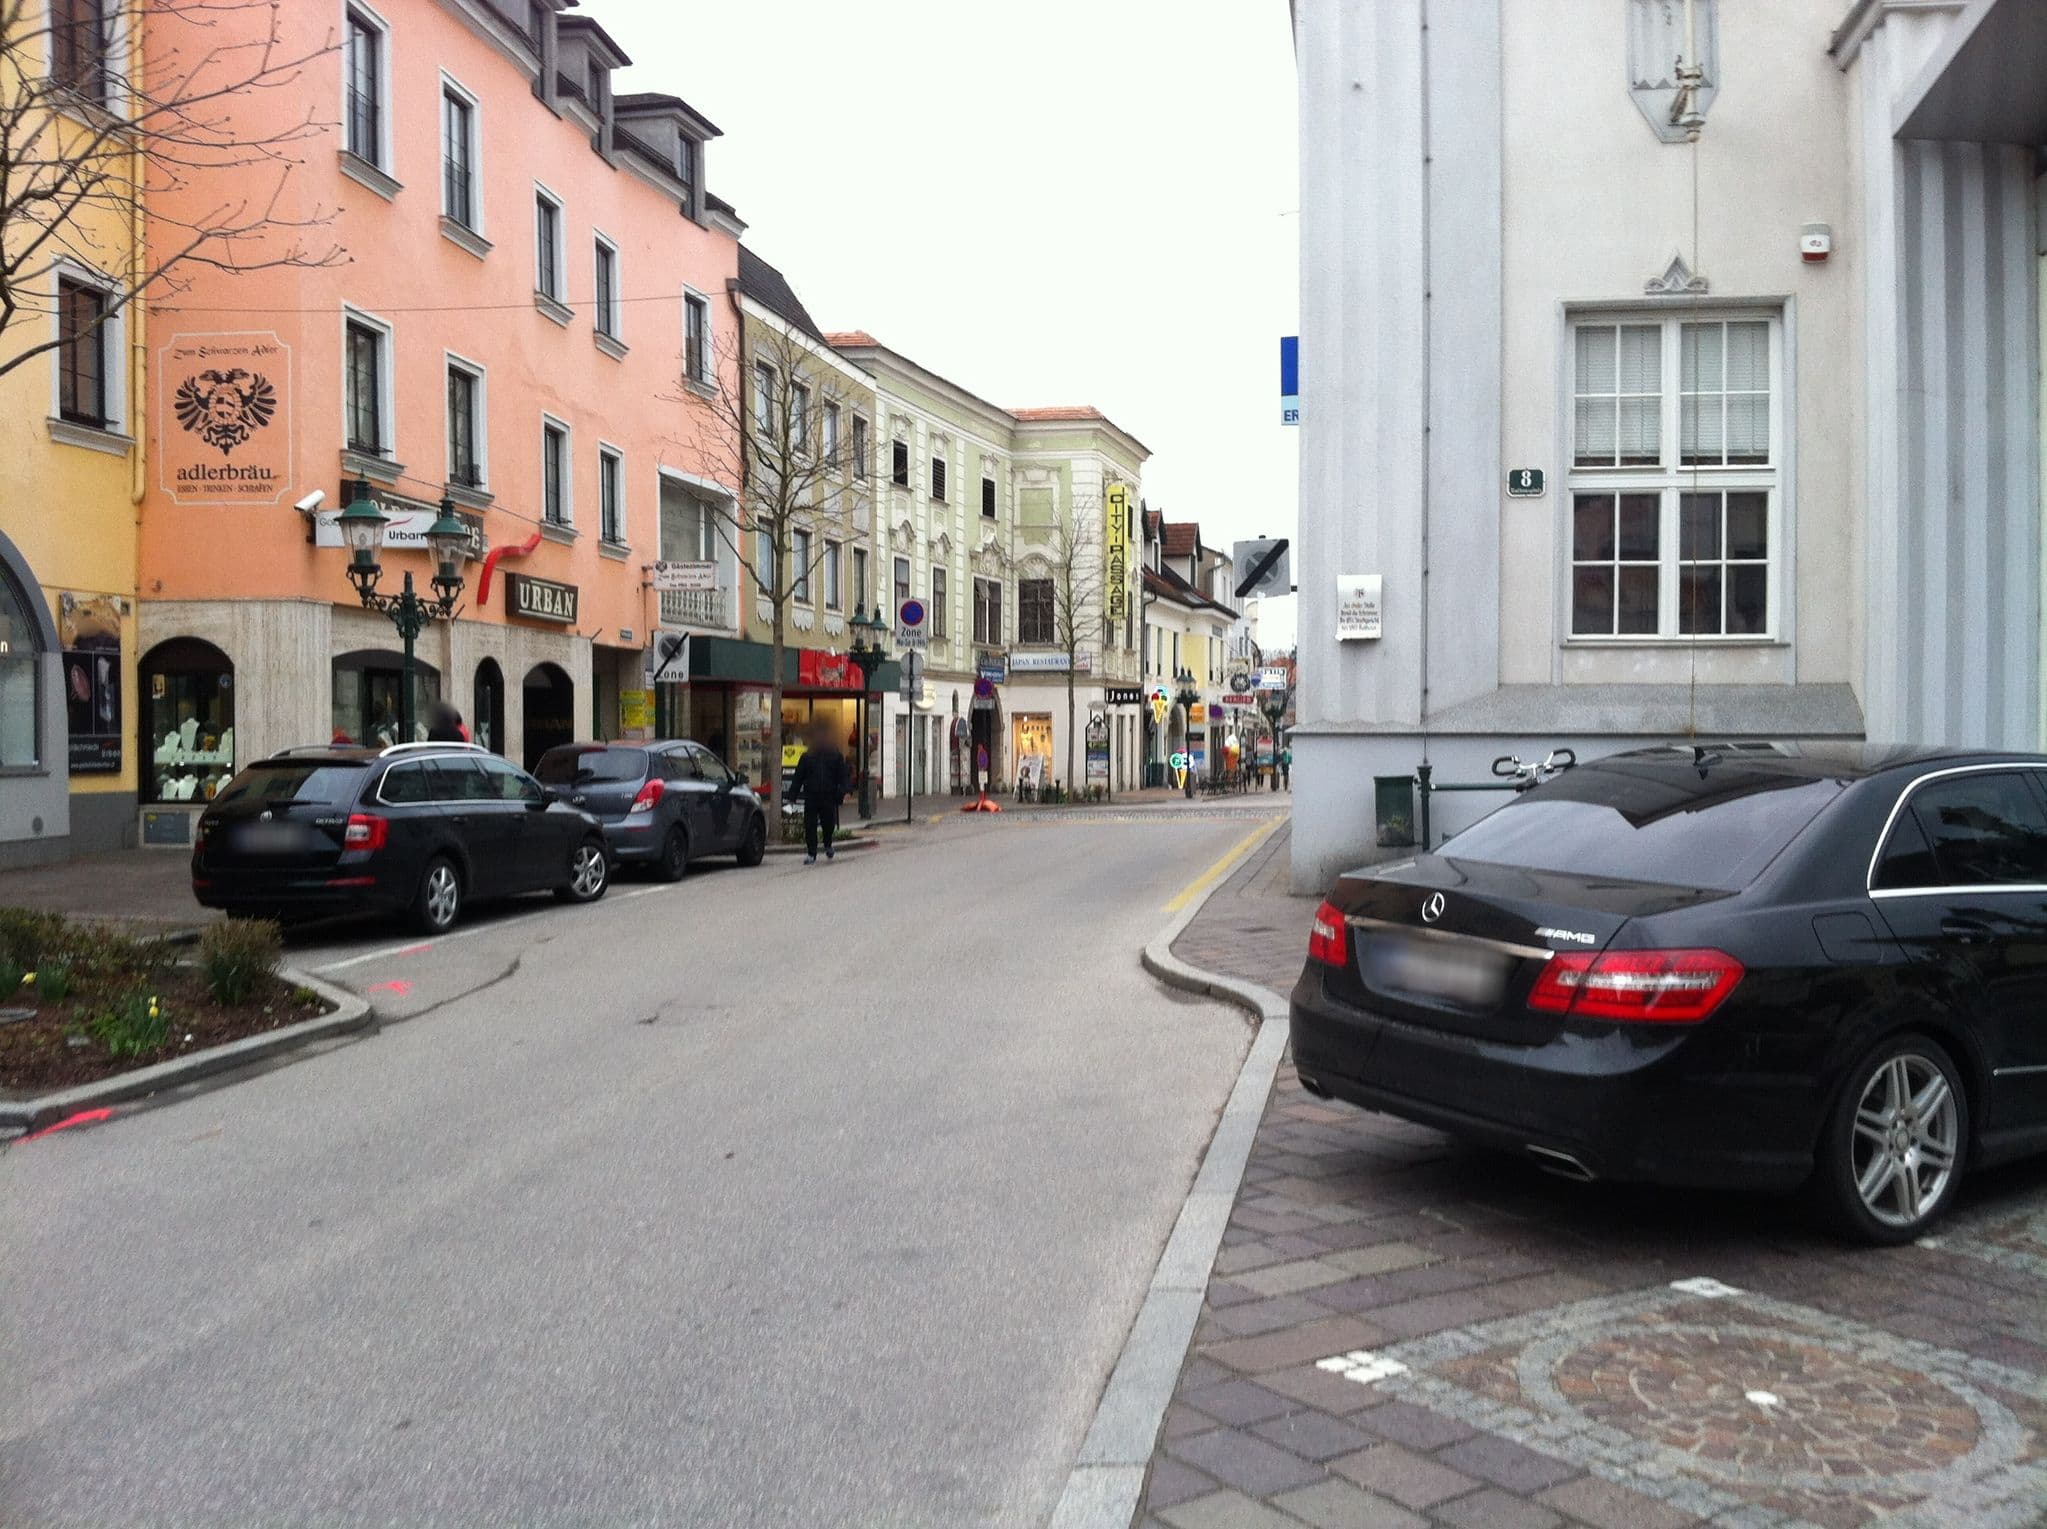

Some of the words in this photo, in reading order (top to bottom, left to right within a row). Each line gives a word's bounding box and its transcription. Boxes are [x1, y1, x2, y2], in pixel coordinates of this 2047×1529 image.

[176, 464, 272, 480] adlerbräu
[1521, 470, 1532, 487] 8
[519, 582, 575, 617] URBAN
[901, 627, 922, 638] Zone
[1552, 928, 1596, 945] AMG
